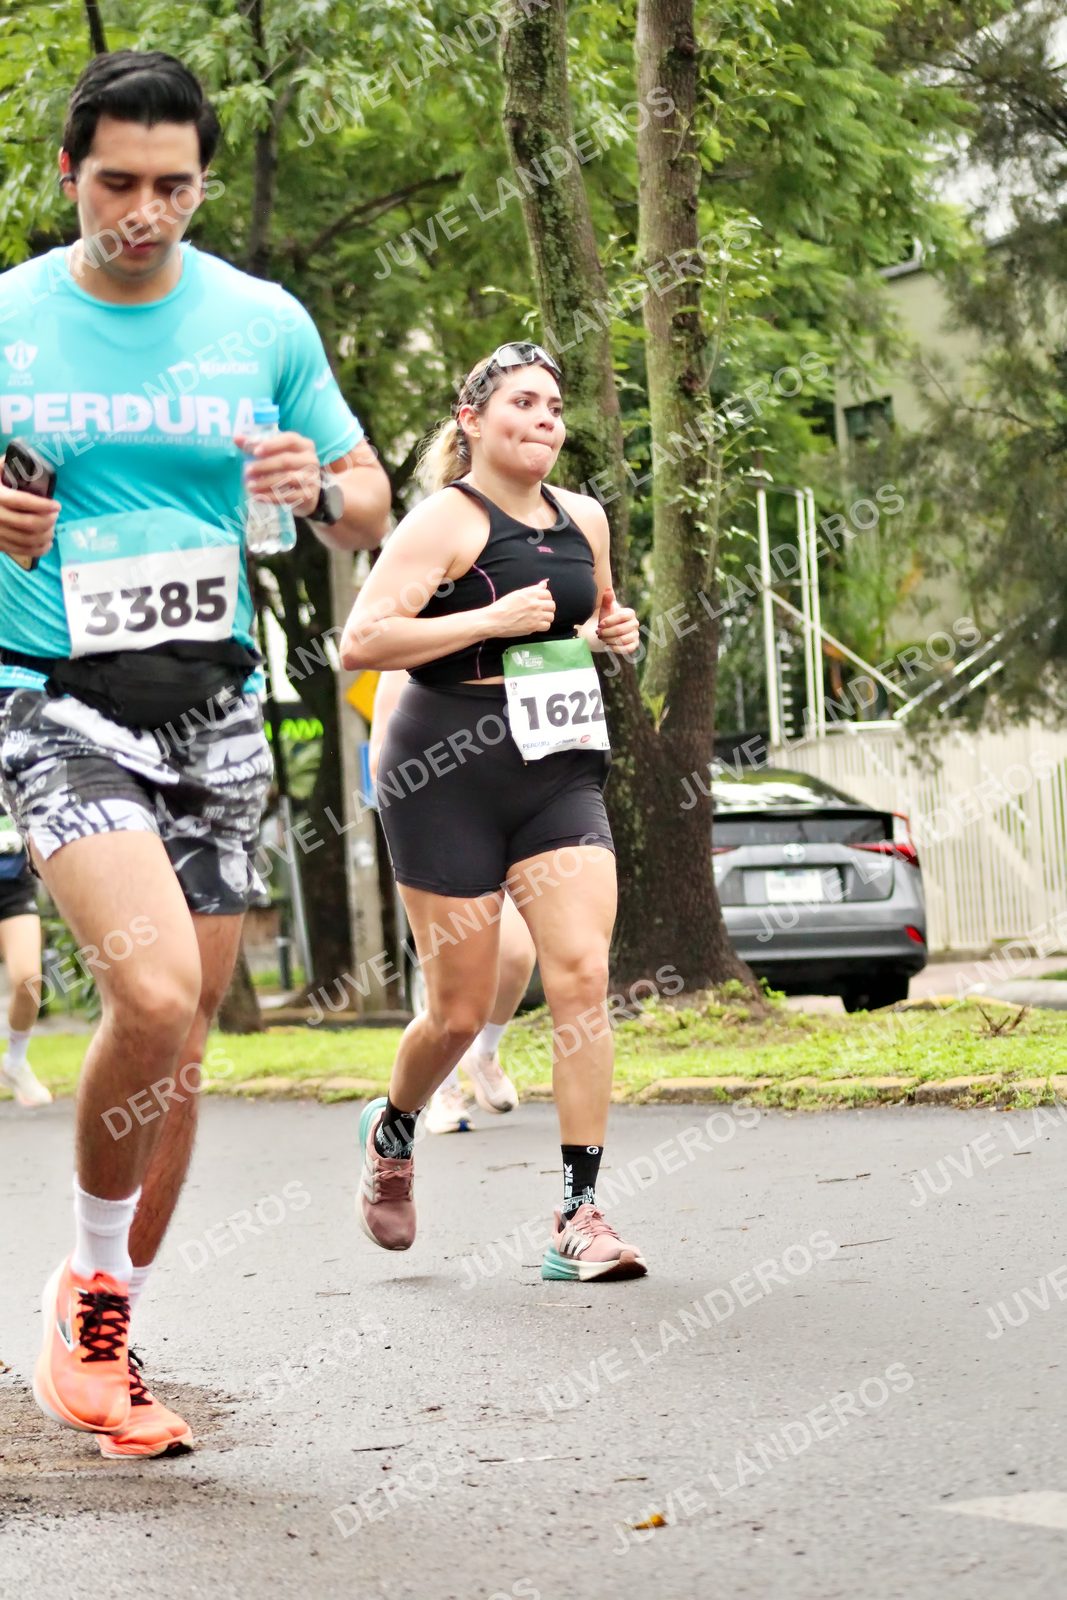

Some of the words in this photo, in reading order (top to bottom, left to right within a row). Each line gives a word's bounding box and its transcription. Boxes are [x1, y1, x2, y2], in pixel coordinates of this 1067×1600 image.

[0, 391, 256, 437] PERDURA
[81, 576, 227, 636] 3385
[520, 689, 604, 730] 1622
